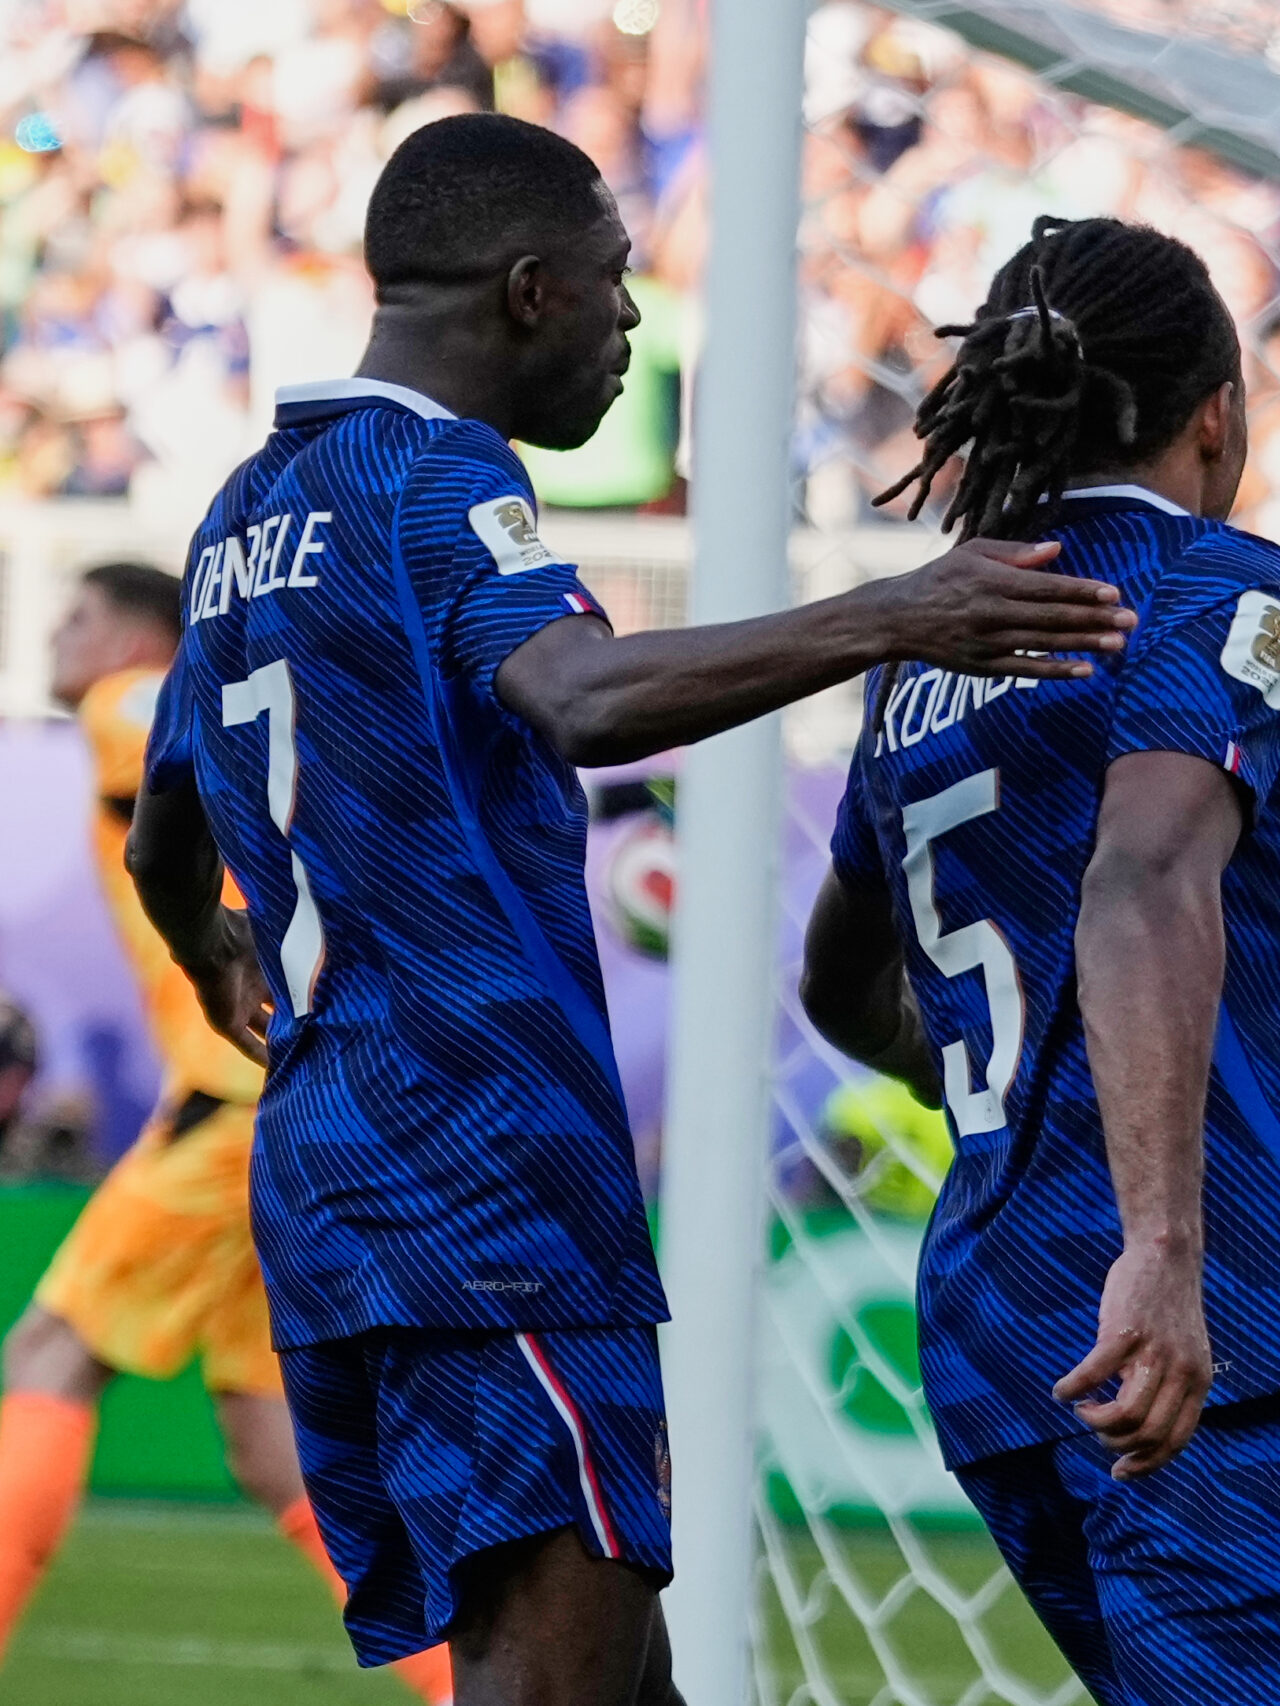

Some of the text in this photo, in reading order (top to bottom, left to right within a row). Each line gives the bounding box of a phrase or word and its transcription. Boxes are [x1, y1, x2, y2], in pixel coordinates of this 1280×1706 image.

[873, 649, 1050, 758] KOUN
[222, 659, 325, 1018] 7
[902, 767, 1026, 1138] 5
[462, 1280, 544, 1293] AERO-FIT
